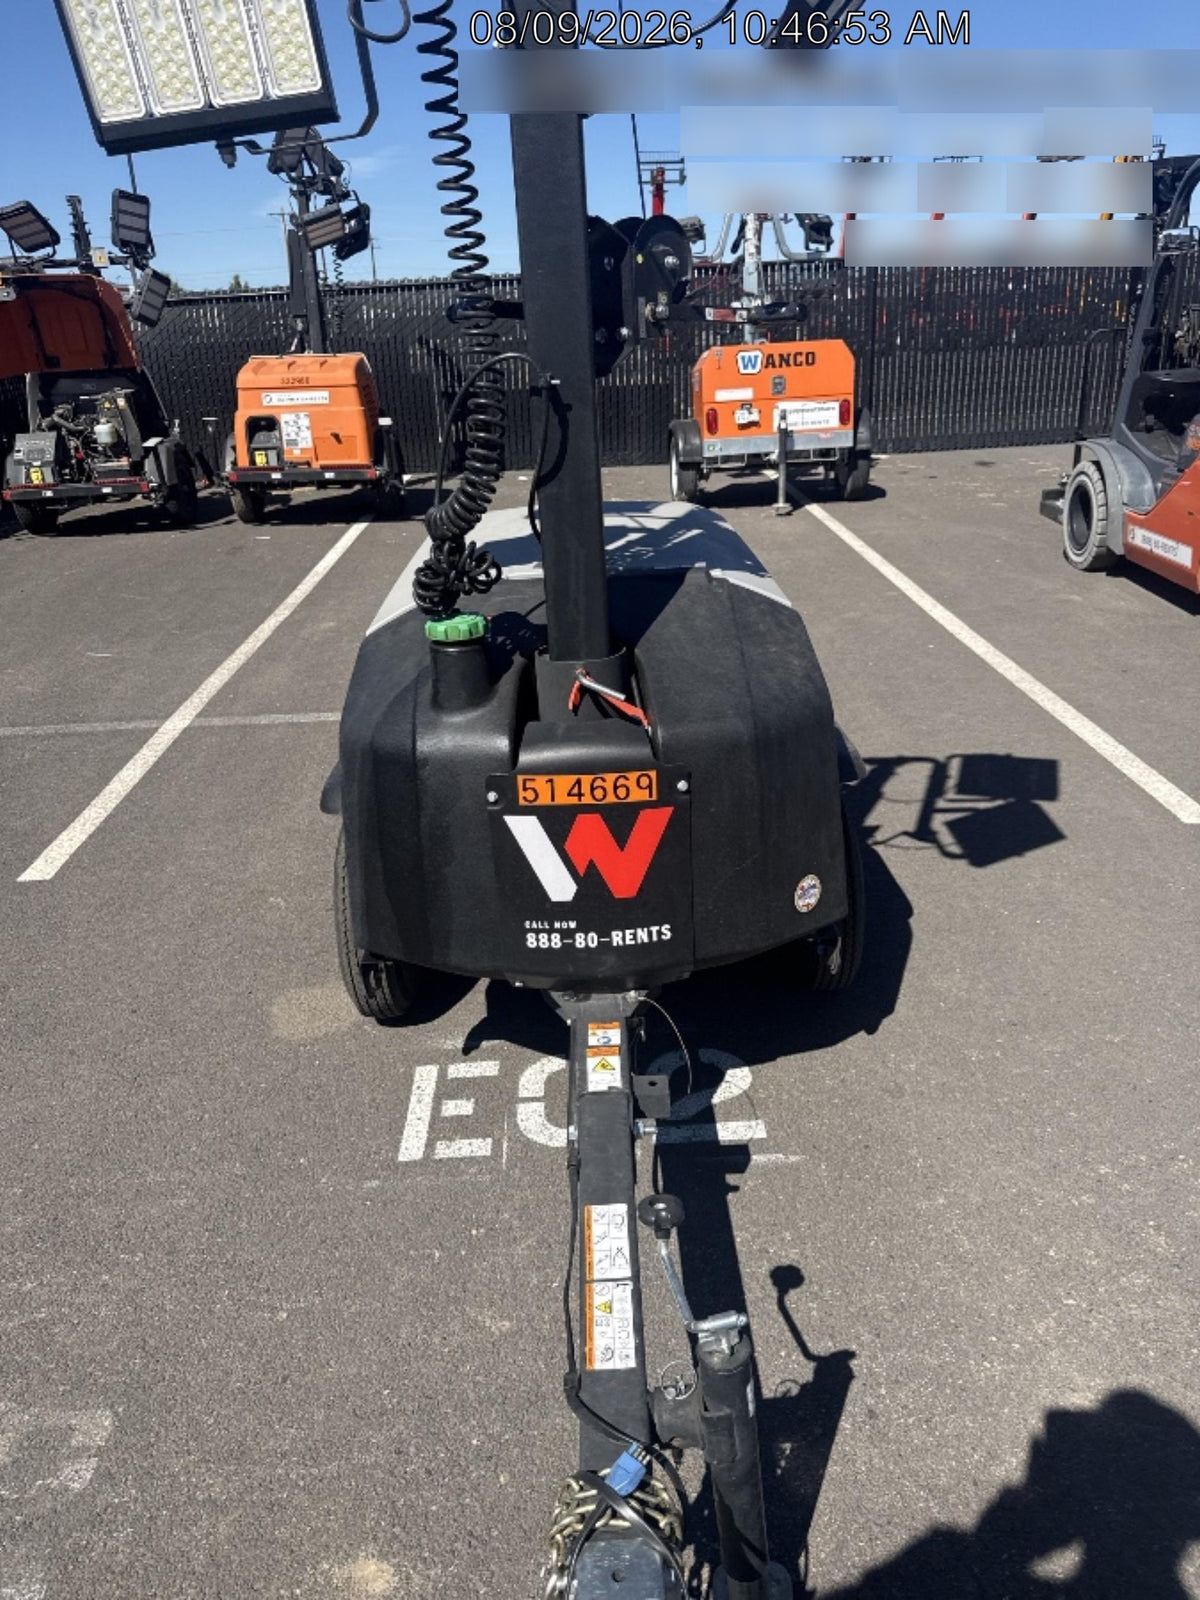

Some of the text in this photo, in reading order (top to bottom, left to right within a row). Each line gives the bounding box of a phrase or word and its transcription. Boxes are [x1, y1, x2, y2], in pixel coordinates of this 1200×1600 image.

[738, 350, 816, 373] WANCO
[521, 773, 654, 803] 514669
[524, 920, 577, 929] CALL NOW
[525, 924, 673, 949] 888-80-RENTS
